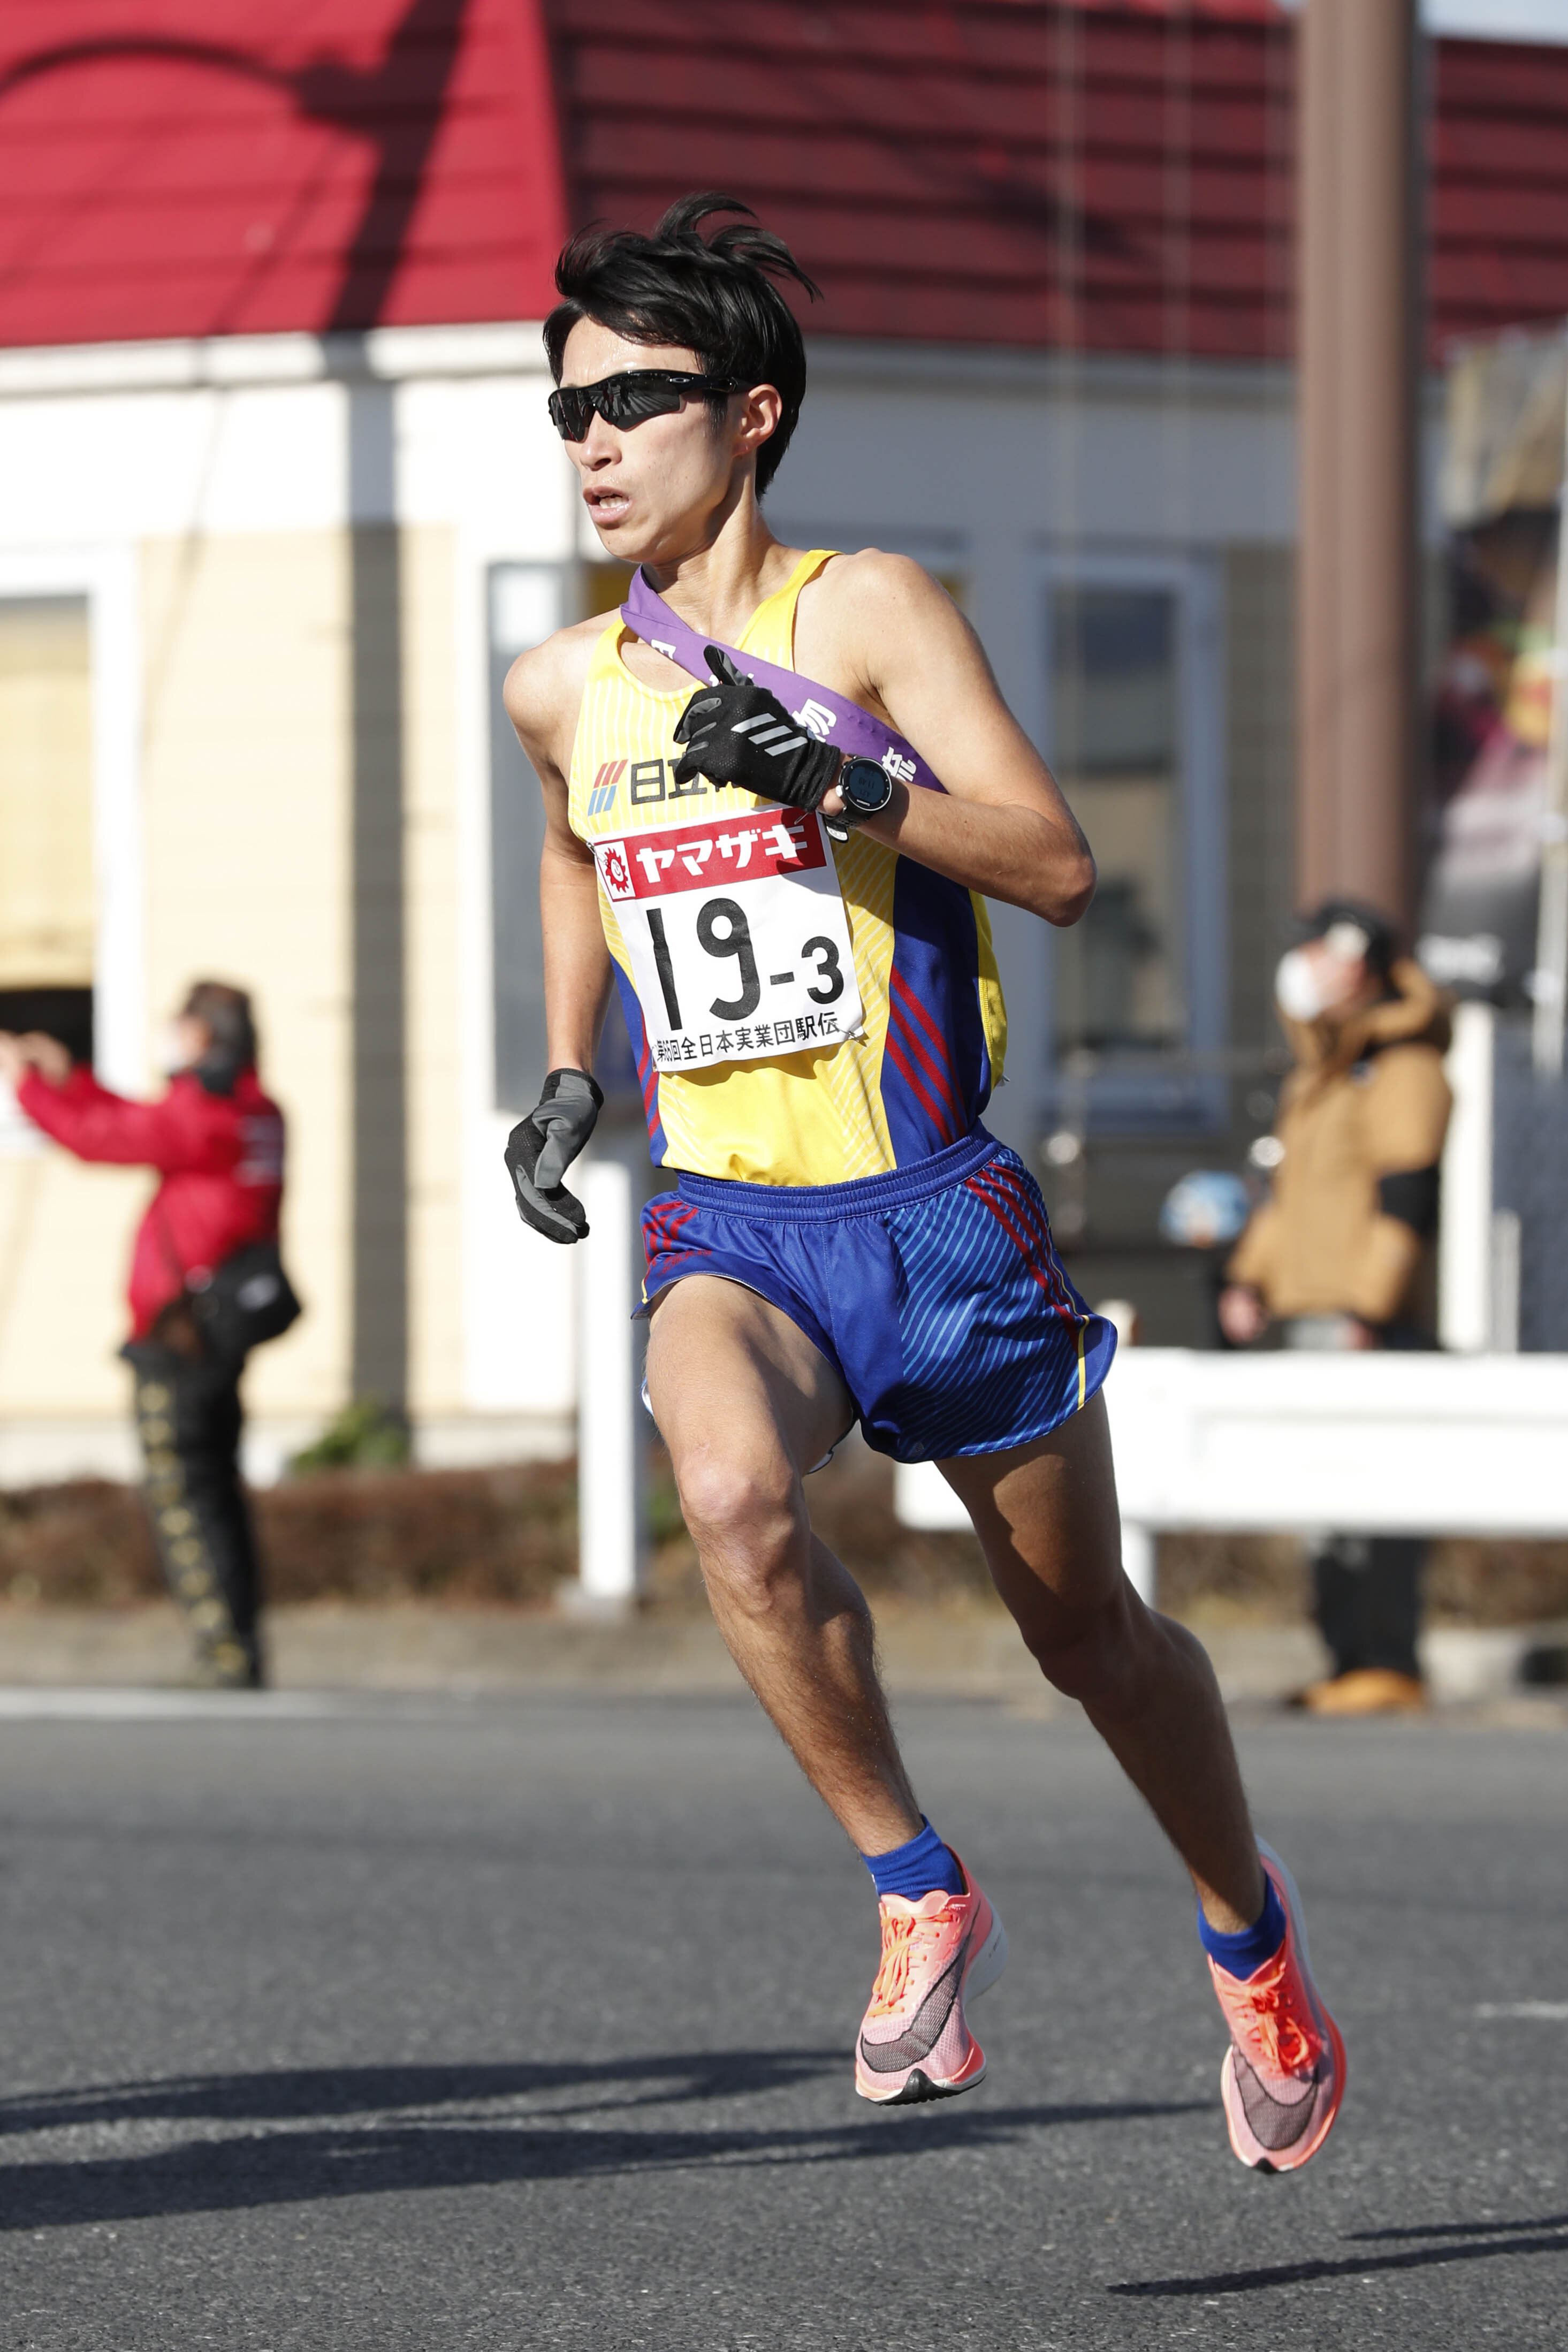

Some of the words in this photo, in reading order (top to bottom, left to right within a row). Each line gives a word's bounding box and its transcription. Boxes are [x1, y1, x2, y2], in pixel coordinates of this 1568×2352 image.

[635, 824, 808, 884] ヤマザキ
[646, 897, 844, 1031] 19-3
